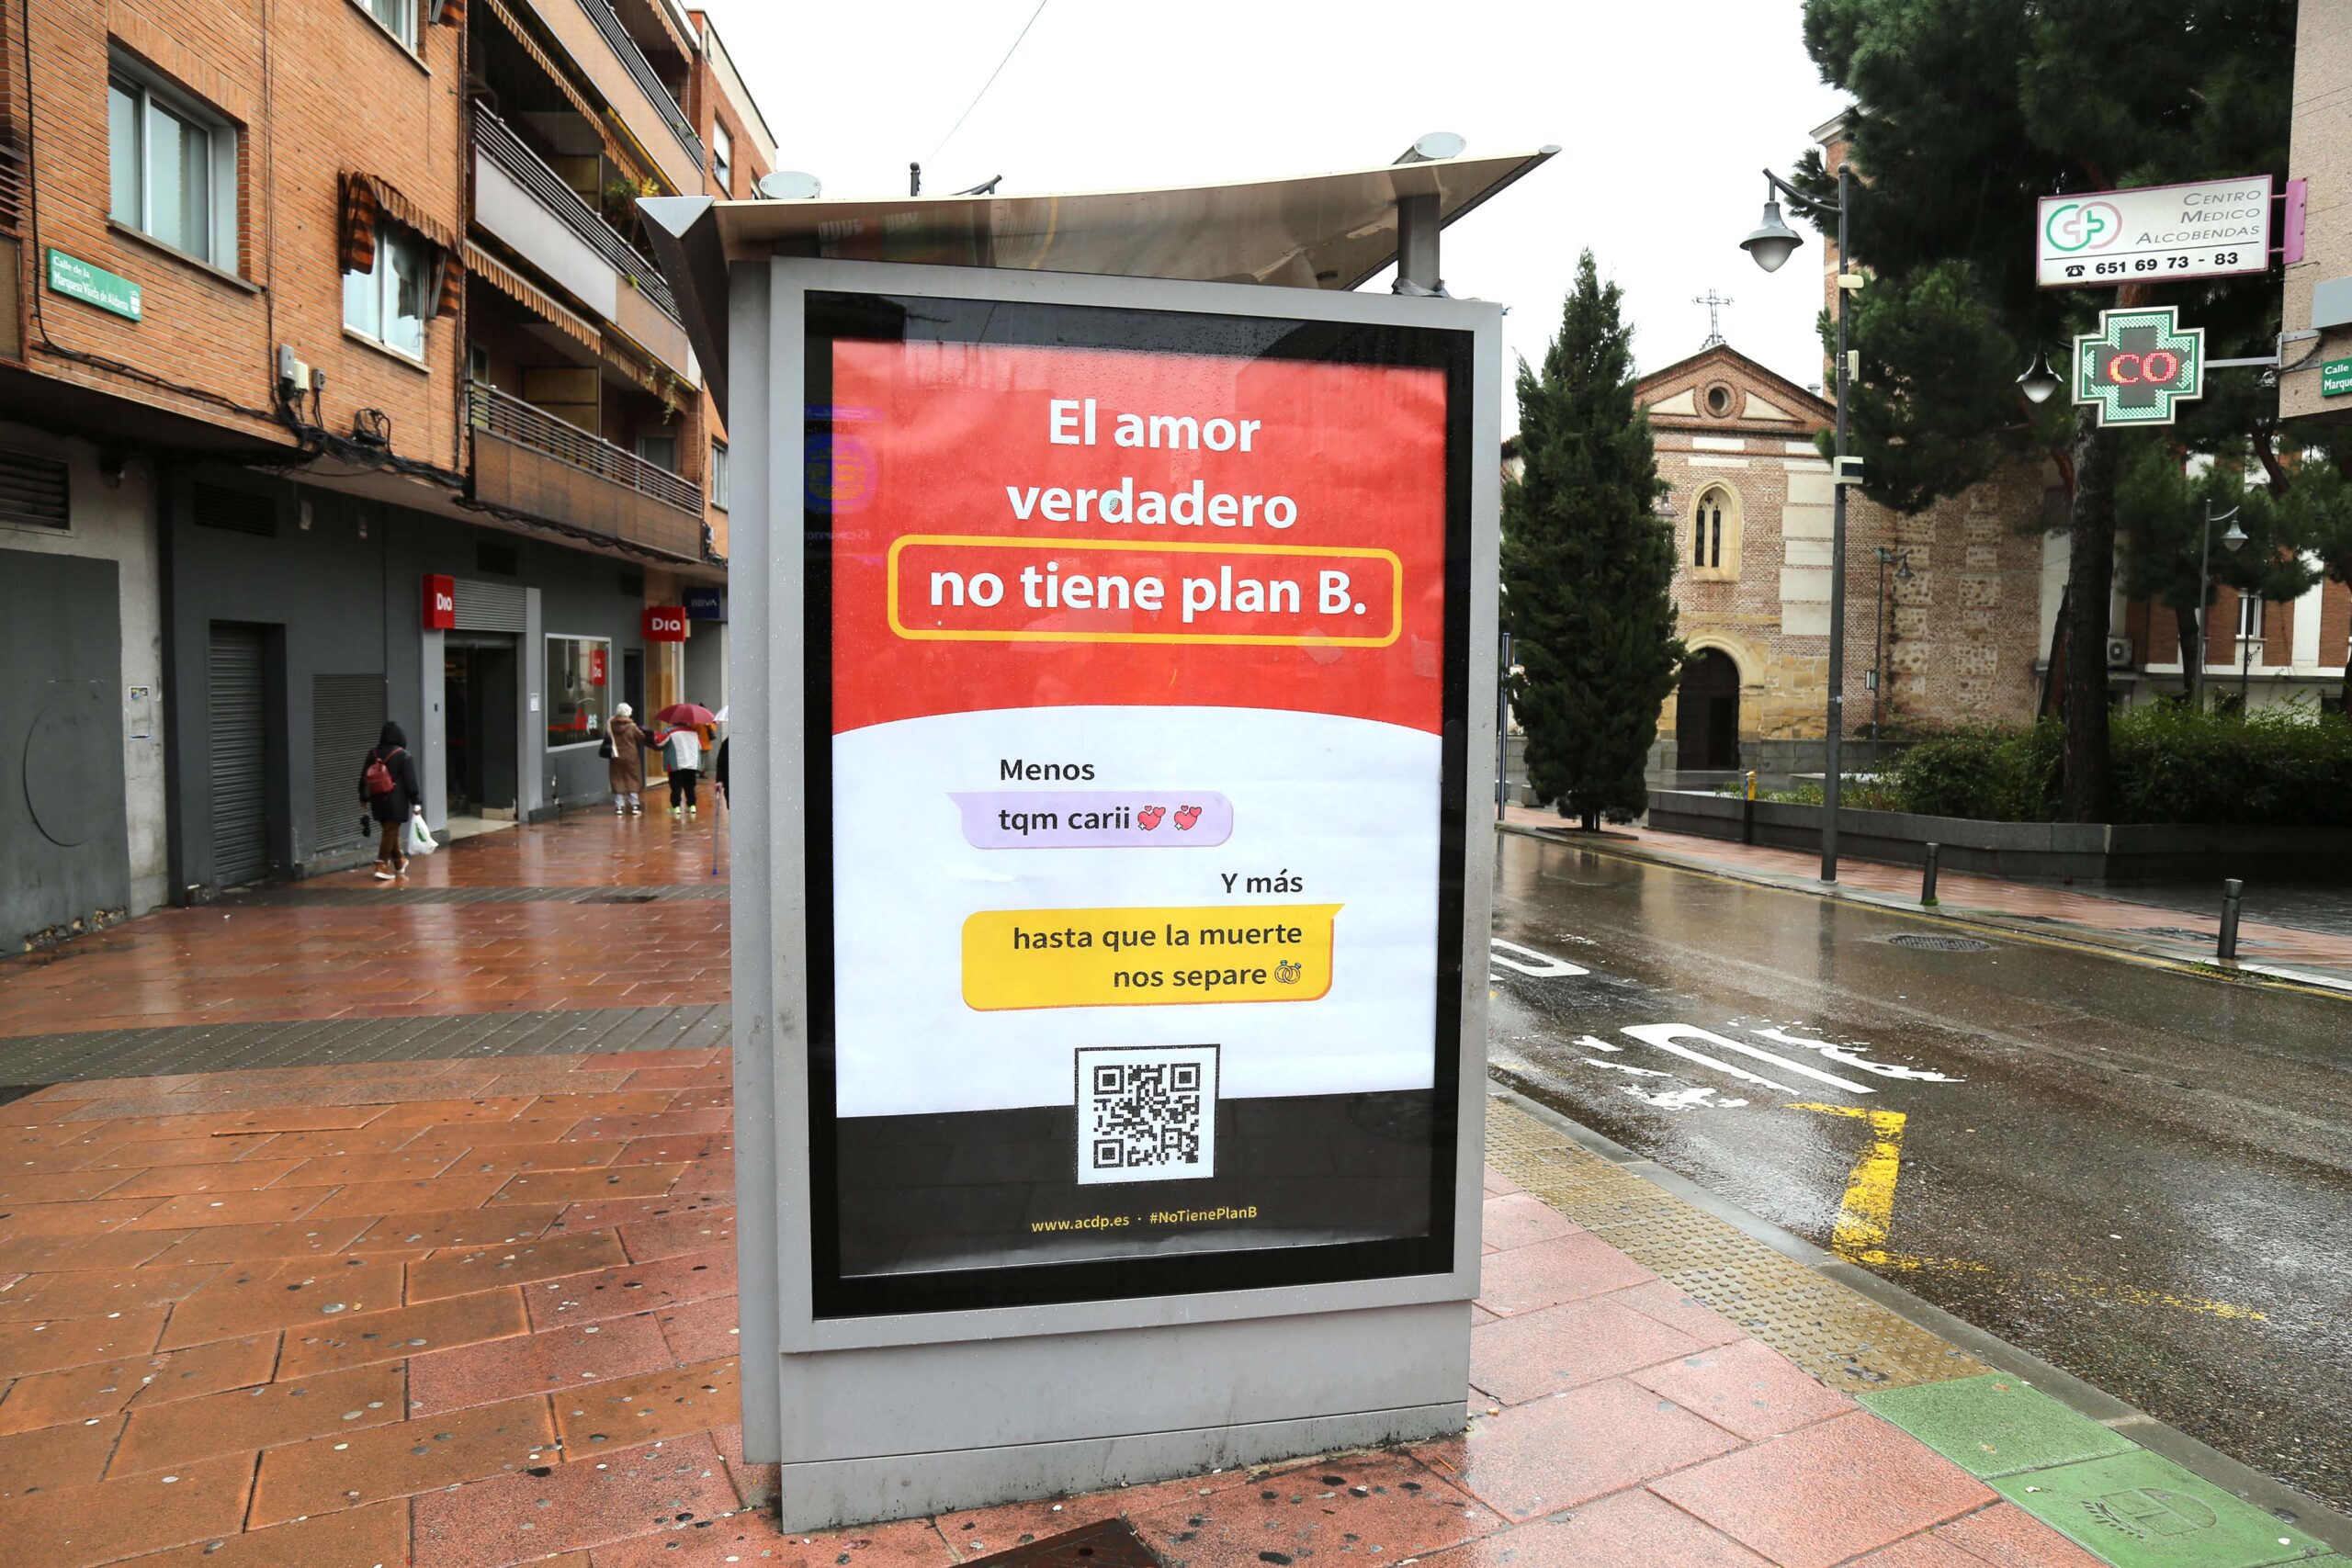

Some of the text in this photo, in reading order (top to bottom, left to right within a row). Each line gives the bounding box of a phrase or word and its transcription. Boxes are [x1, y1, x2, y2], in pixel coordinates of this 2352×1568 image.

[2183, 189, 2261, 206] CENTRO
[2180, 208, 2260, 224] MEDICO
[2136, 225, 2260, 245] ALCOBENDAS
[53, 255, 72, 272] Calle
[74, 265, 83, 276] de
[2095, 262, 2126, 275] 651
[2134, 258, 2158, 272] 69
[2166, 256, 2189, 269] 73
[2214, 252, 2238, 265] 83
[2109, 352, 2178, 384] CO
[2324, 364, 2349, 375] Calle
[1049, 397, 1262, 453] El amor
[1006, 477, 1298, 530] verdadero
[930, 561, 1367, 624] no tiene plan B.
[1001, 759, 1096, 782] Menos
[998, 806, 1131, 836] tqm carii
[1221, 868, 1304, 895] Y más
[1014, 923, 1303, 953] hasta que la muerte
[1114, 966, 1268, 992] nos separe
[1031, 1214, 1130, 1232] www.acdp.es
[1149, 1205, 1258, 1224] #NoTienePlanB
